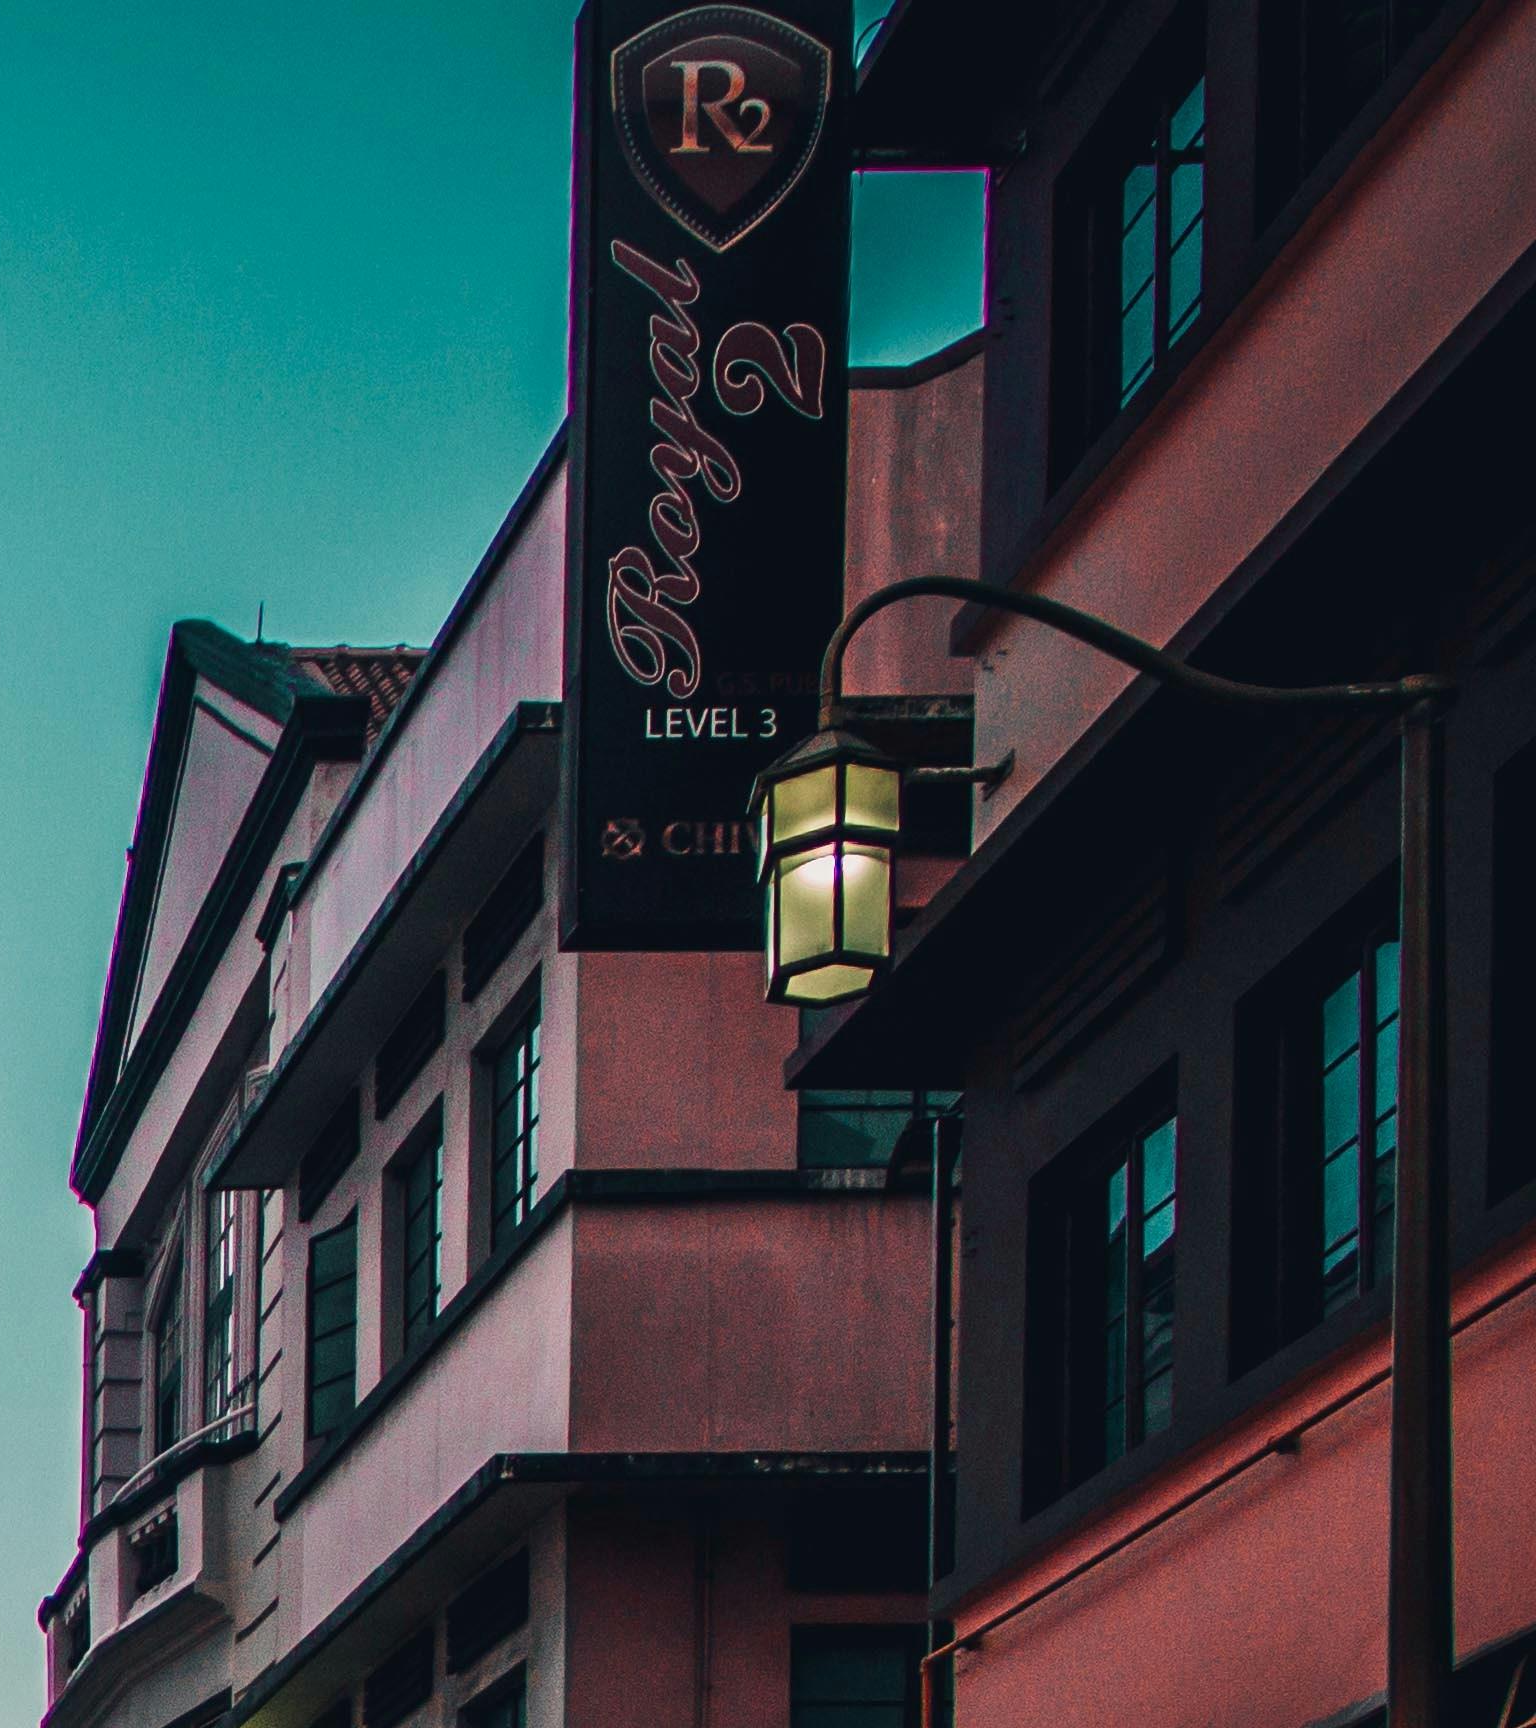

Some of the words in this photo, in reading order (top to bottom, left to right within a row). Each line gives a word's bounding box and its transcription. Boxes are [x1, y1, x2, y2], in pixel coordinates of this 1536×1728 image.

[713, 321, 826, 420] 2
[608, 239, 742, 700] Royal
[645, 708, 748, 739] LEVEL
[759, 708, 777, 739] 3
